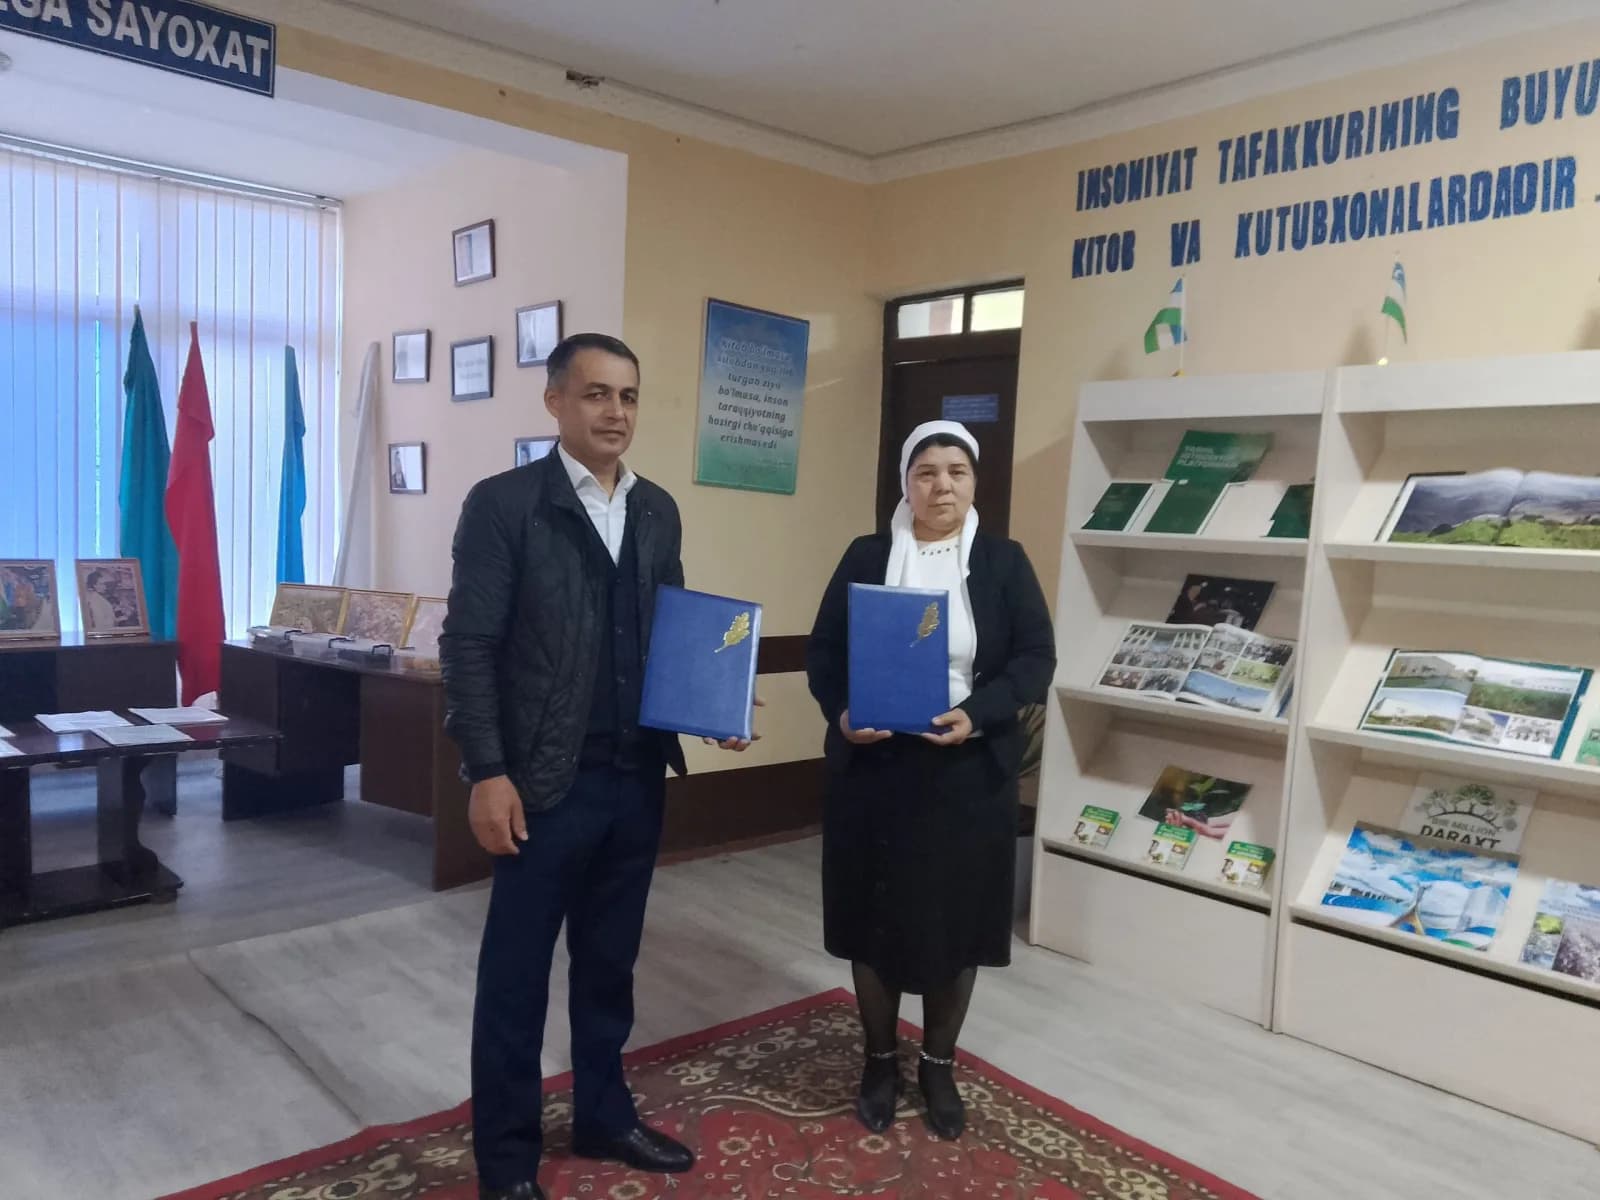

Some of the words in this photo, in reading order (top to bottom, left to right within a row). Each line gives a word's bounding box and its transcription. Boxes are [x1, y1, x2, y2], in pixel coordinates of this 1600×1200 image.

[87, 0, 269, 77] SAYOXAT
[1076, 147, 1197, 211] INSONIYAT
[1217, 87, 1460, 184] TAFAKKURINING
[1071, 230, 1136, 278] KITOB
[1171, 220, 1200, 267] VA
